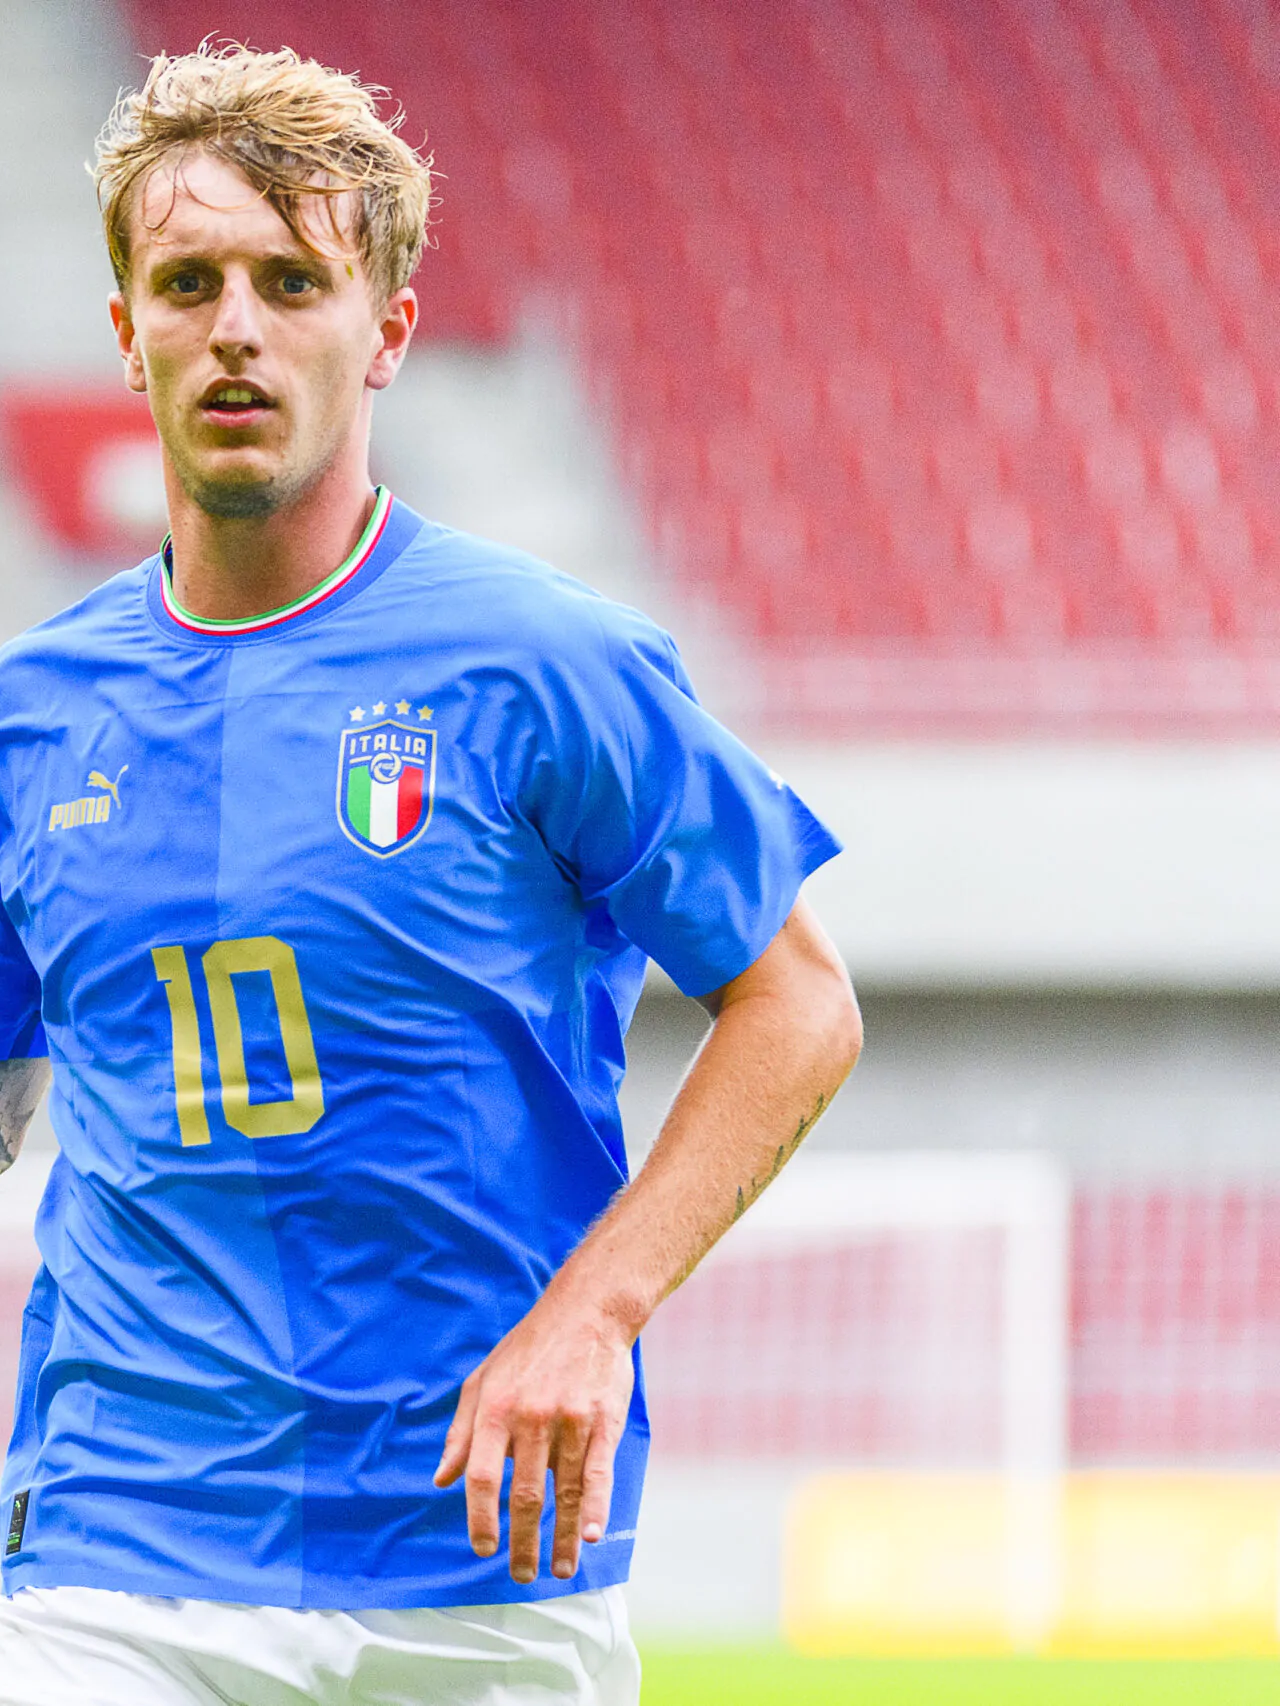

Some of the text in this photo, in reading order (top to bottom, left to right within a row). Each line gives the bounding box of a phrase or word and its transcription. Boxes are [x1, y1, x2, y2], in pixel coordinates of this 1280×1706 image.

[350, 734, 426, 756] ITALIA
[48, 795, 111, 831] PUMA
[151, 935, 325, 1147] 10
